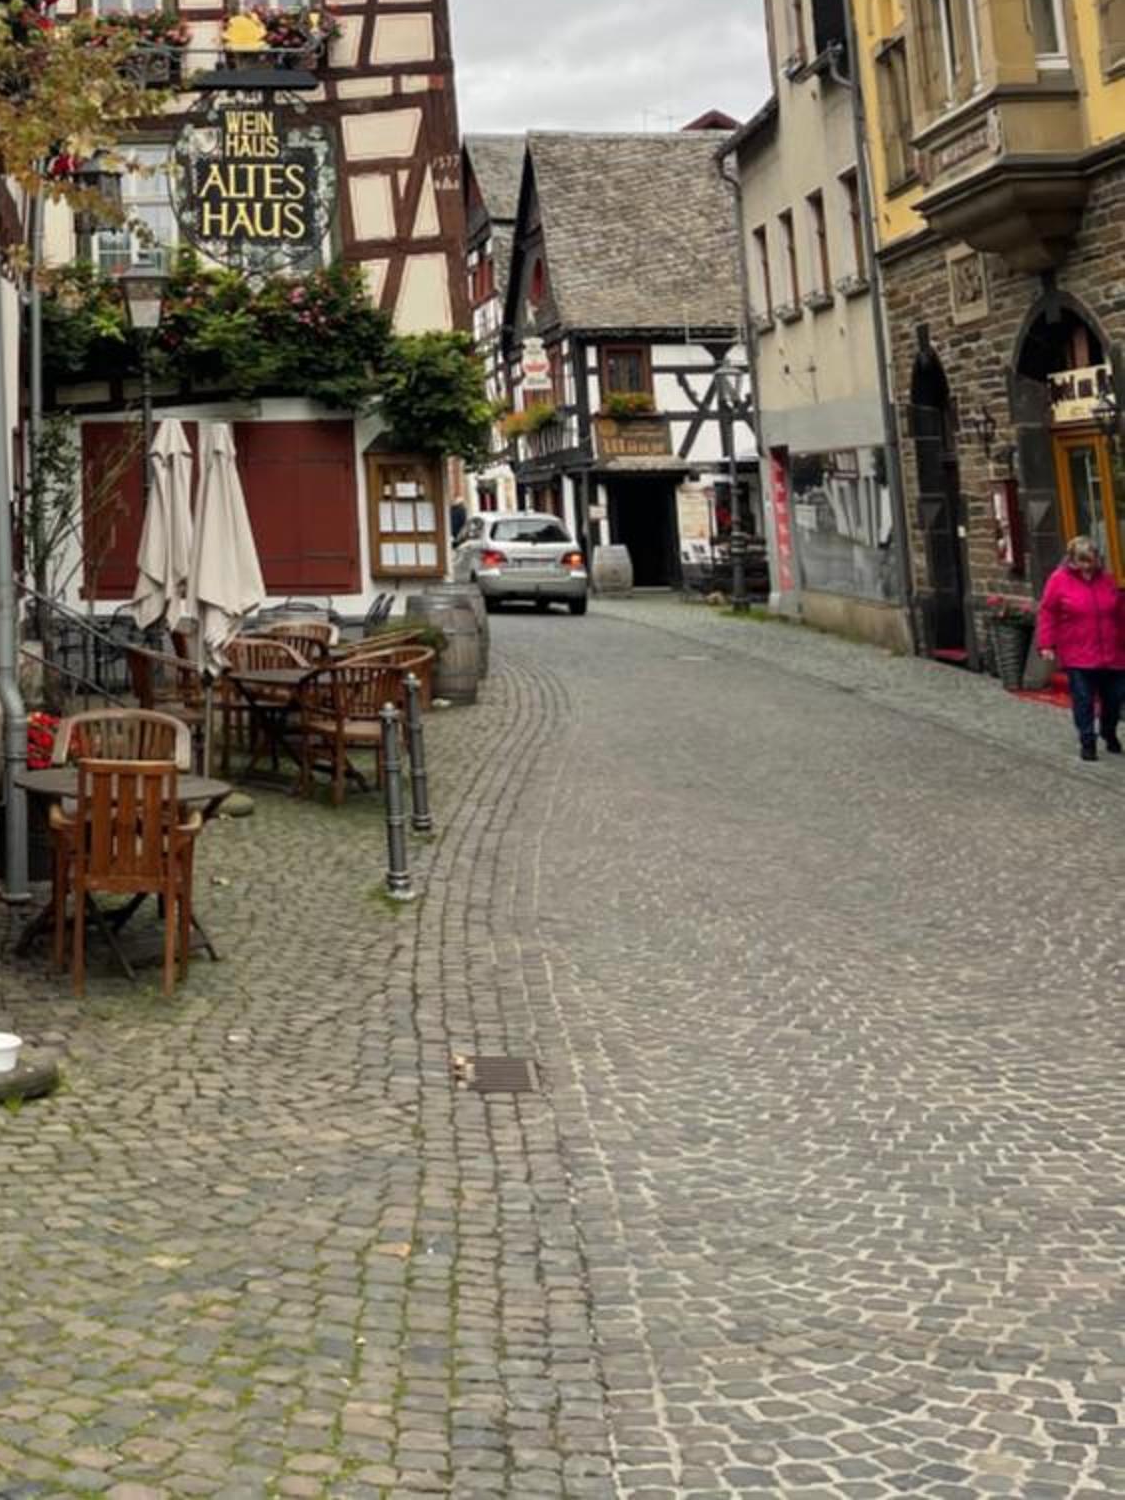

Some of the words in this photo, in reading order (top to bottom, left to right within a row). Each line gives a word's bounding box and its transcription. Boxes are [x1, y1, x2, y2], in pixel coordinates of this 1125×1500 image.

[225, 110, 274, 133] WEIN
[226, 134, 280, 158] HAUS
[199, 163, 306, 200] ALTES
[202, 201, 306, 239] HAUS
